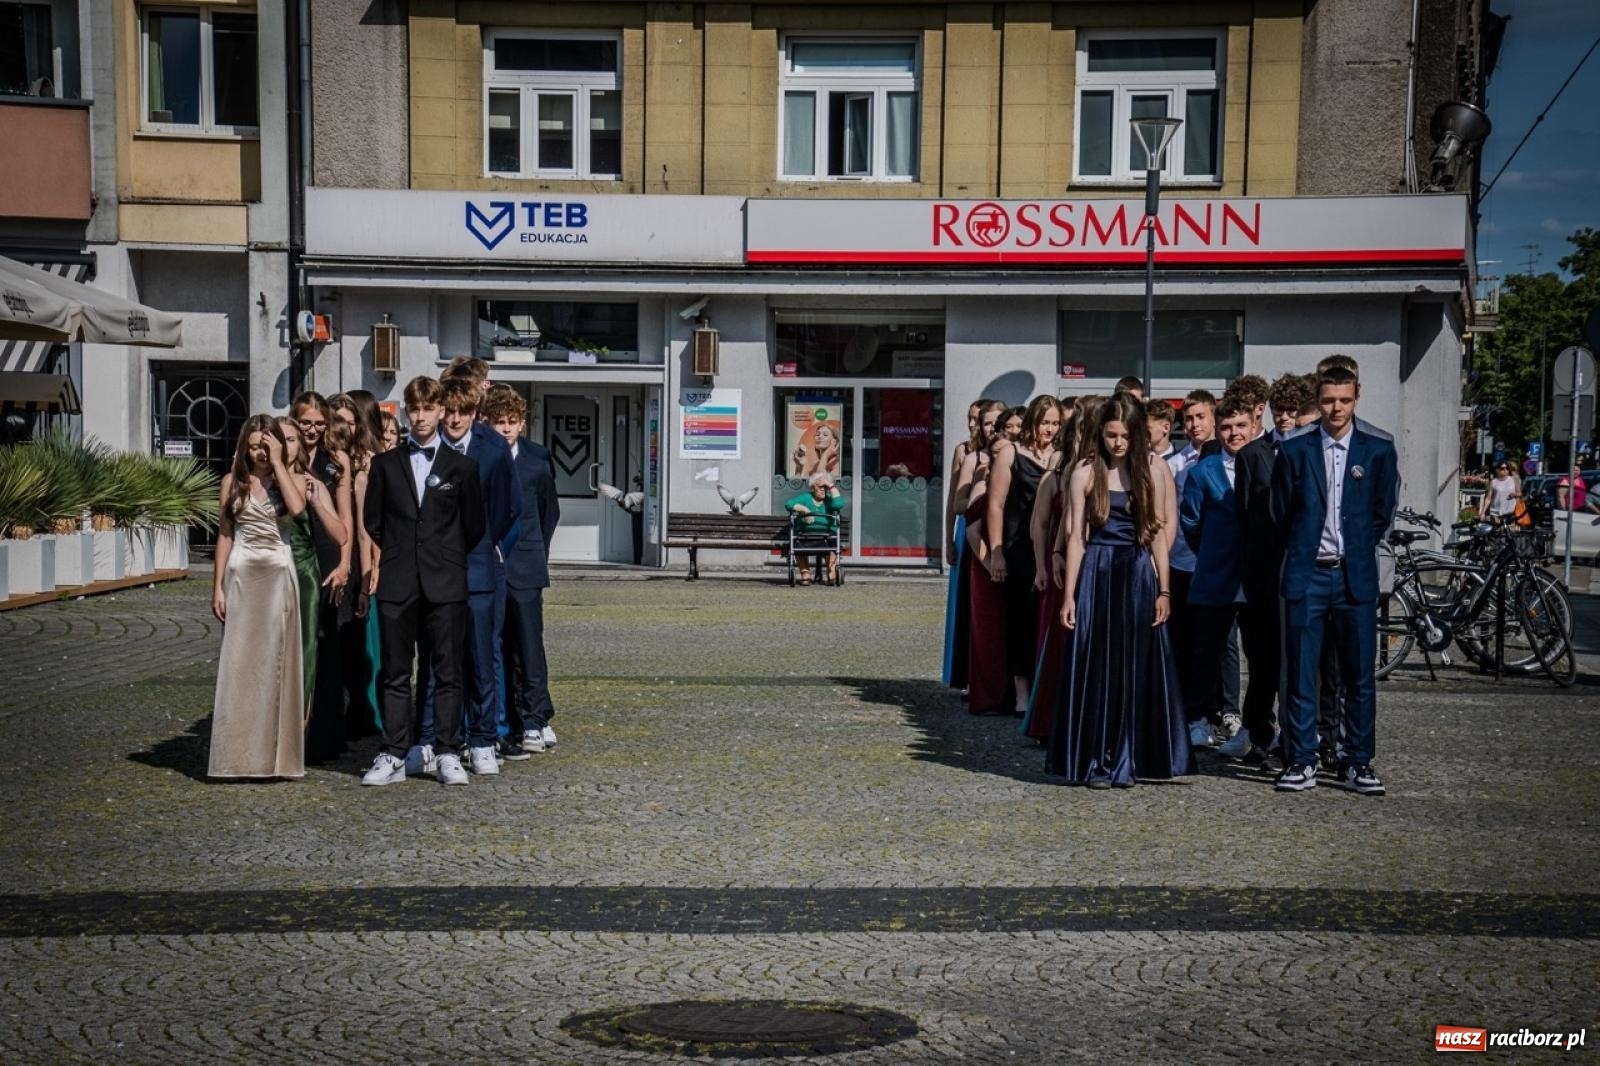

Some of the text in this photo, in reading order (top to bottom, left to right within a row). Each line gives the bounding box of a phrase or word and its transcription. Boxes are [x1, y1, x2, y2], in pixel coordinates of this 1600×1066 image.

[521, 202, 588, 228] TEB
[932, 203, 1260, 247] ROSSMANN
[520, 233, 588, 244] EDUKACJA
[552, 415, 591, 432] TEB
